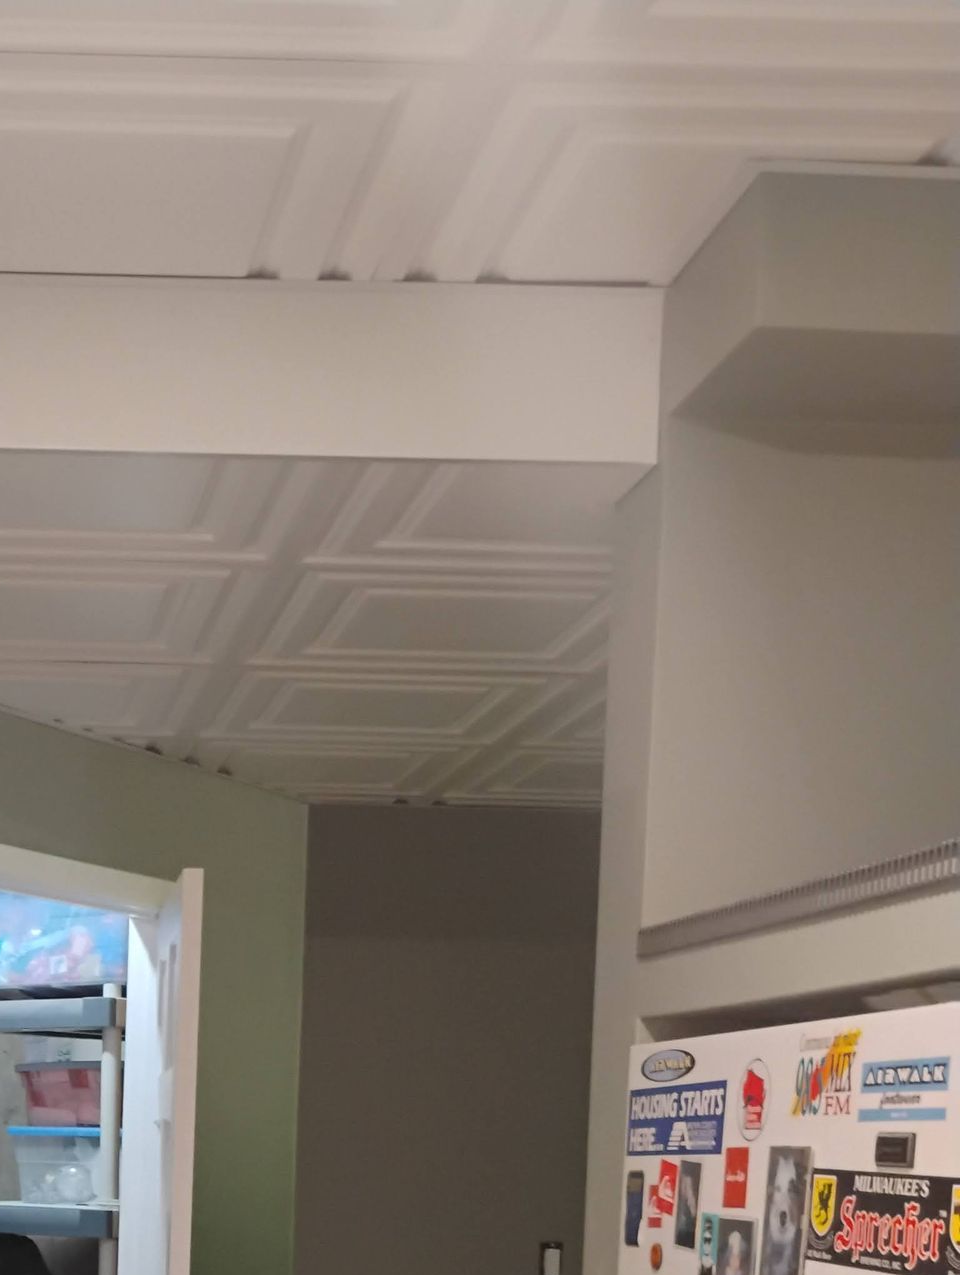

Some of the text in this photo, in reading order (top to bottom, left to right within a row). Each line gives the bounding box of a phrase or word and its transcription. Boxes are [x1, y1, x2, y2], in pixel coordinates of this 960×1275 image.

[863, 1063, 947, 1087] AIRWALK
[630, 1088, 724, 1120] HOUSING STARTS
[824, 1095, 851, 1115] FM
[853, 1175, 930, 1198] MILWAUKEE'S
[834, 1195, 945, 1270] Sprecher
